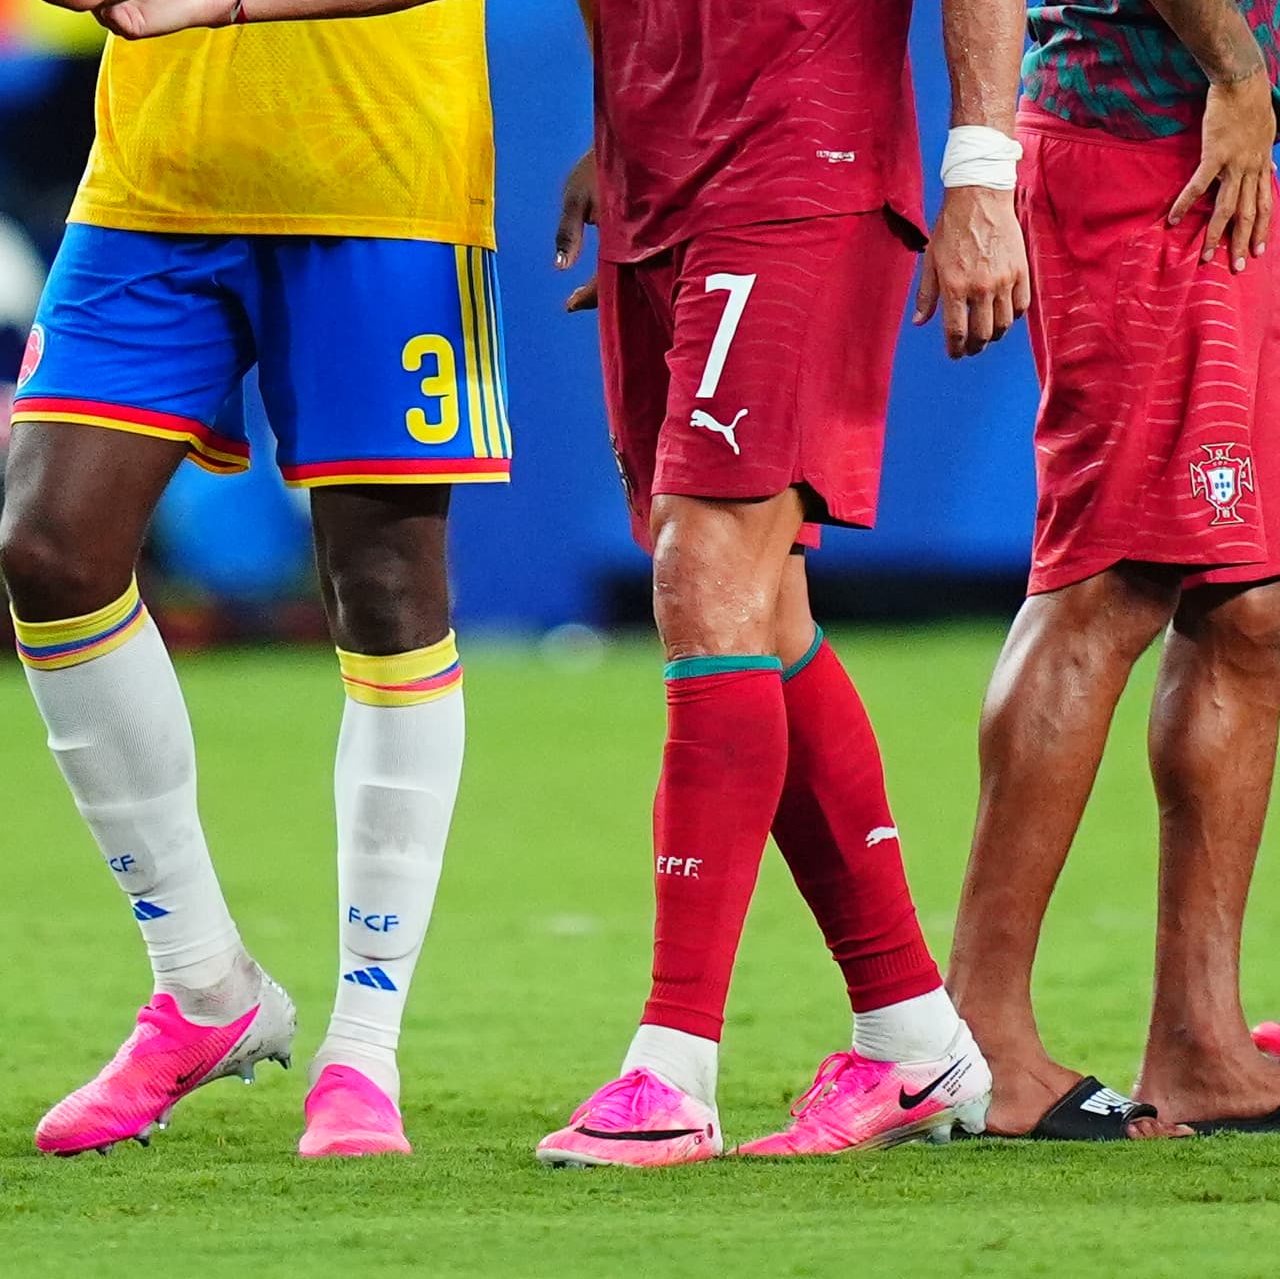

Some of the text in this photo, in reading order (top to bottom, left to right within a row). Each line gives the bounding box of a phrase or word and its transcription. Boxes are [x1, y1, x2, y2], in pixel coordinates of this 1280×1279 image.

[695, 273, 757, 399] 7
[402, 334, 460, 445] 3
[109, 854, 135, 872] CF
[348, 906, 400, 932] FCF
